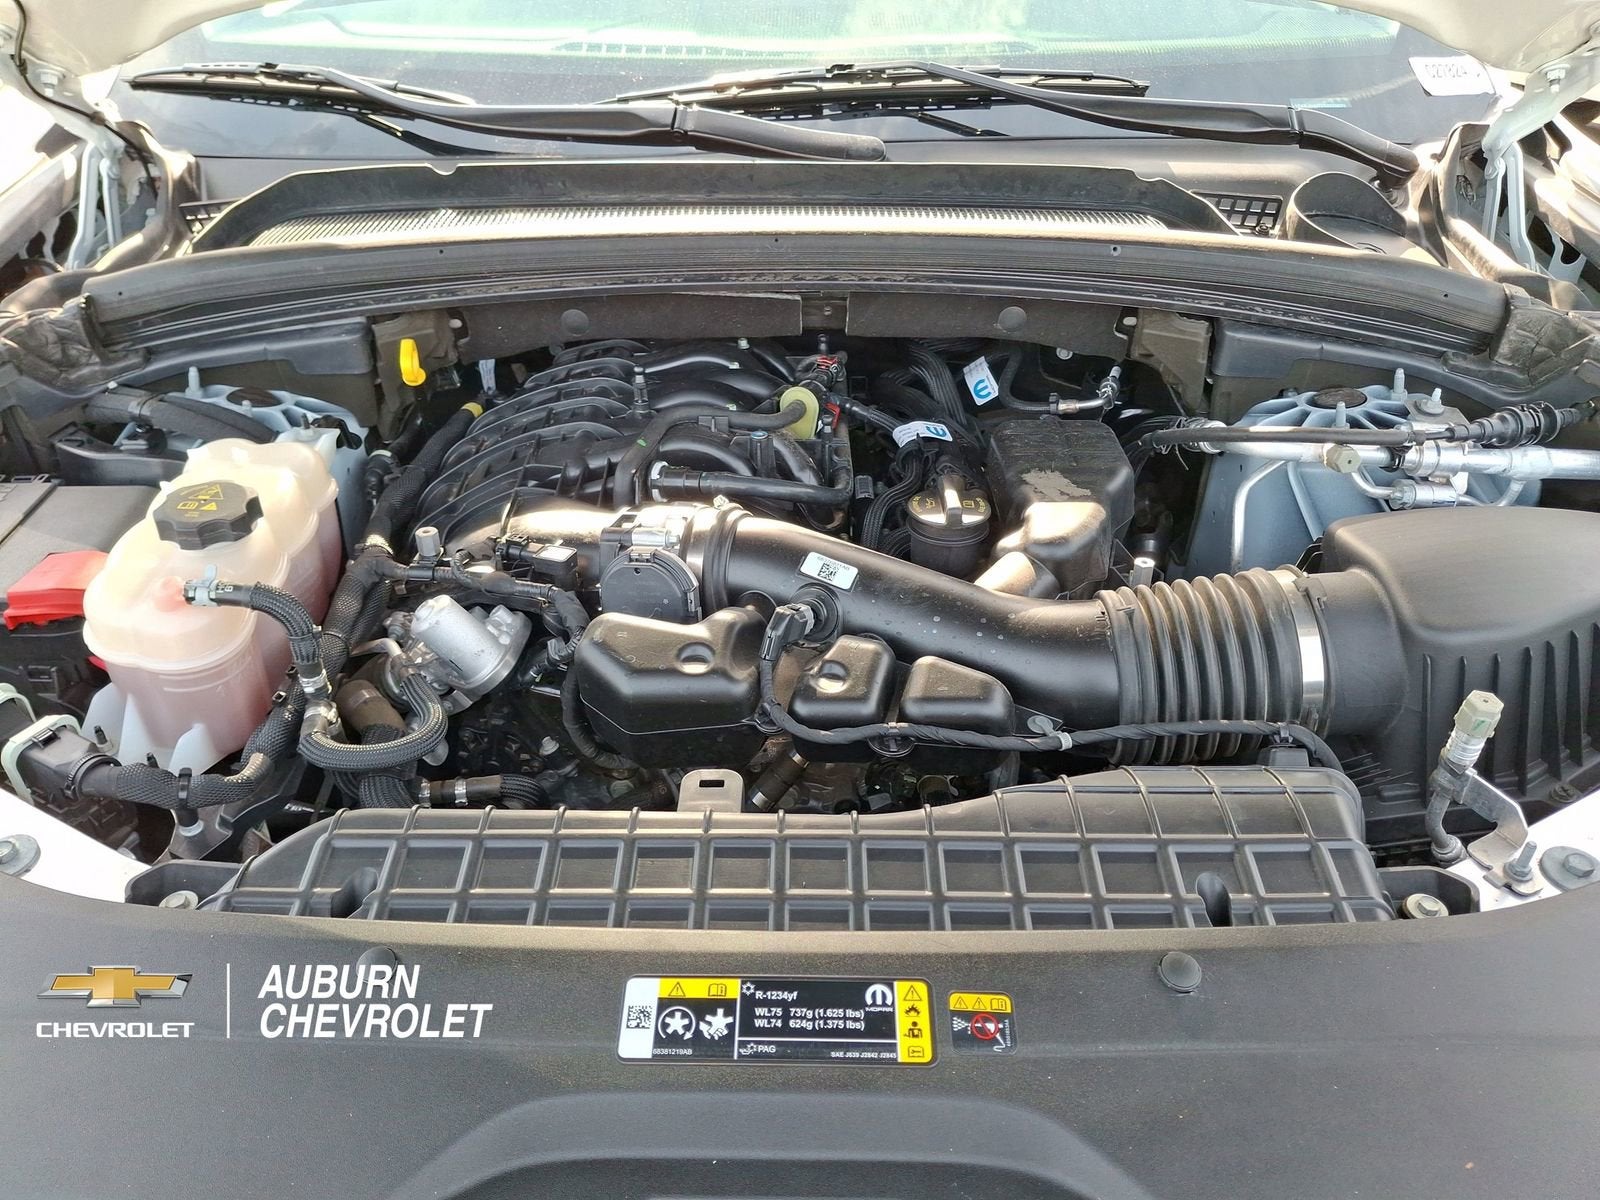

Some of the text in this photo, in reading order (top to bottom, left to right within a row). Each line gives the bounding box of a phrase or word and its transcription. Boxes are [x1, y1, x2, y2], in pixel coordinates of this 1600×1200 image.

[755, 991, 798, 1001] R-1234yf
[754, 1007, 865, 1019] WL75 737g (1.625 lbs)
[754, 1019, 865, 1030] WL74 624g (1.375 lbs)
[758, 1045, 776, 1053] PAG
